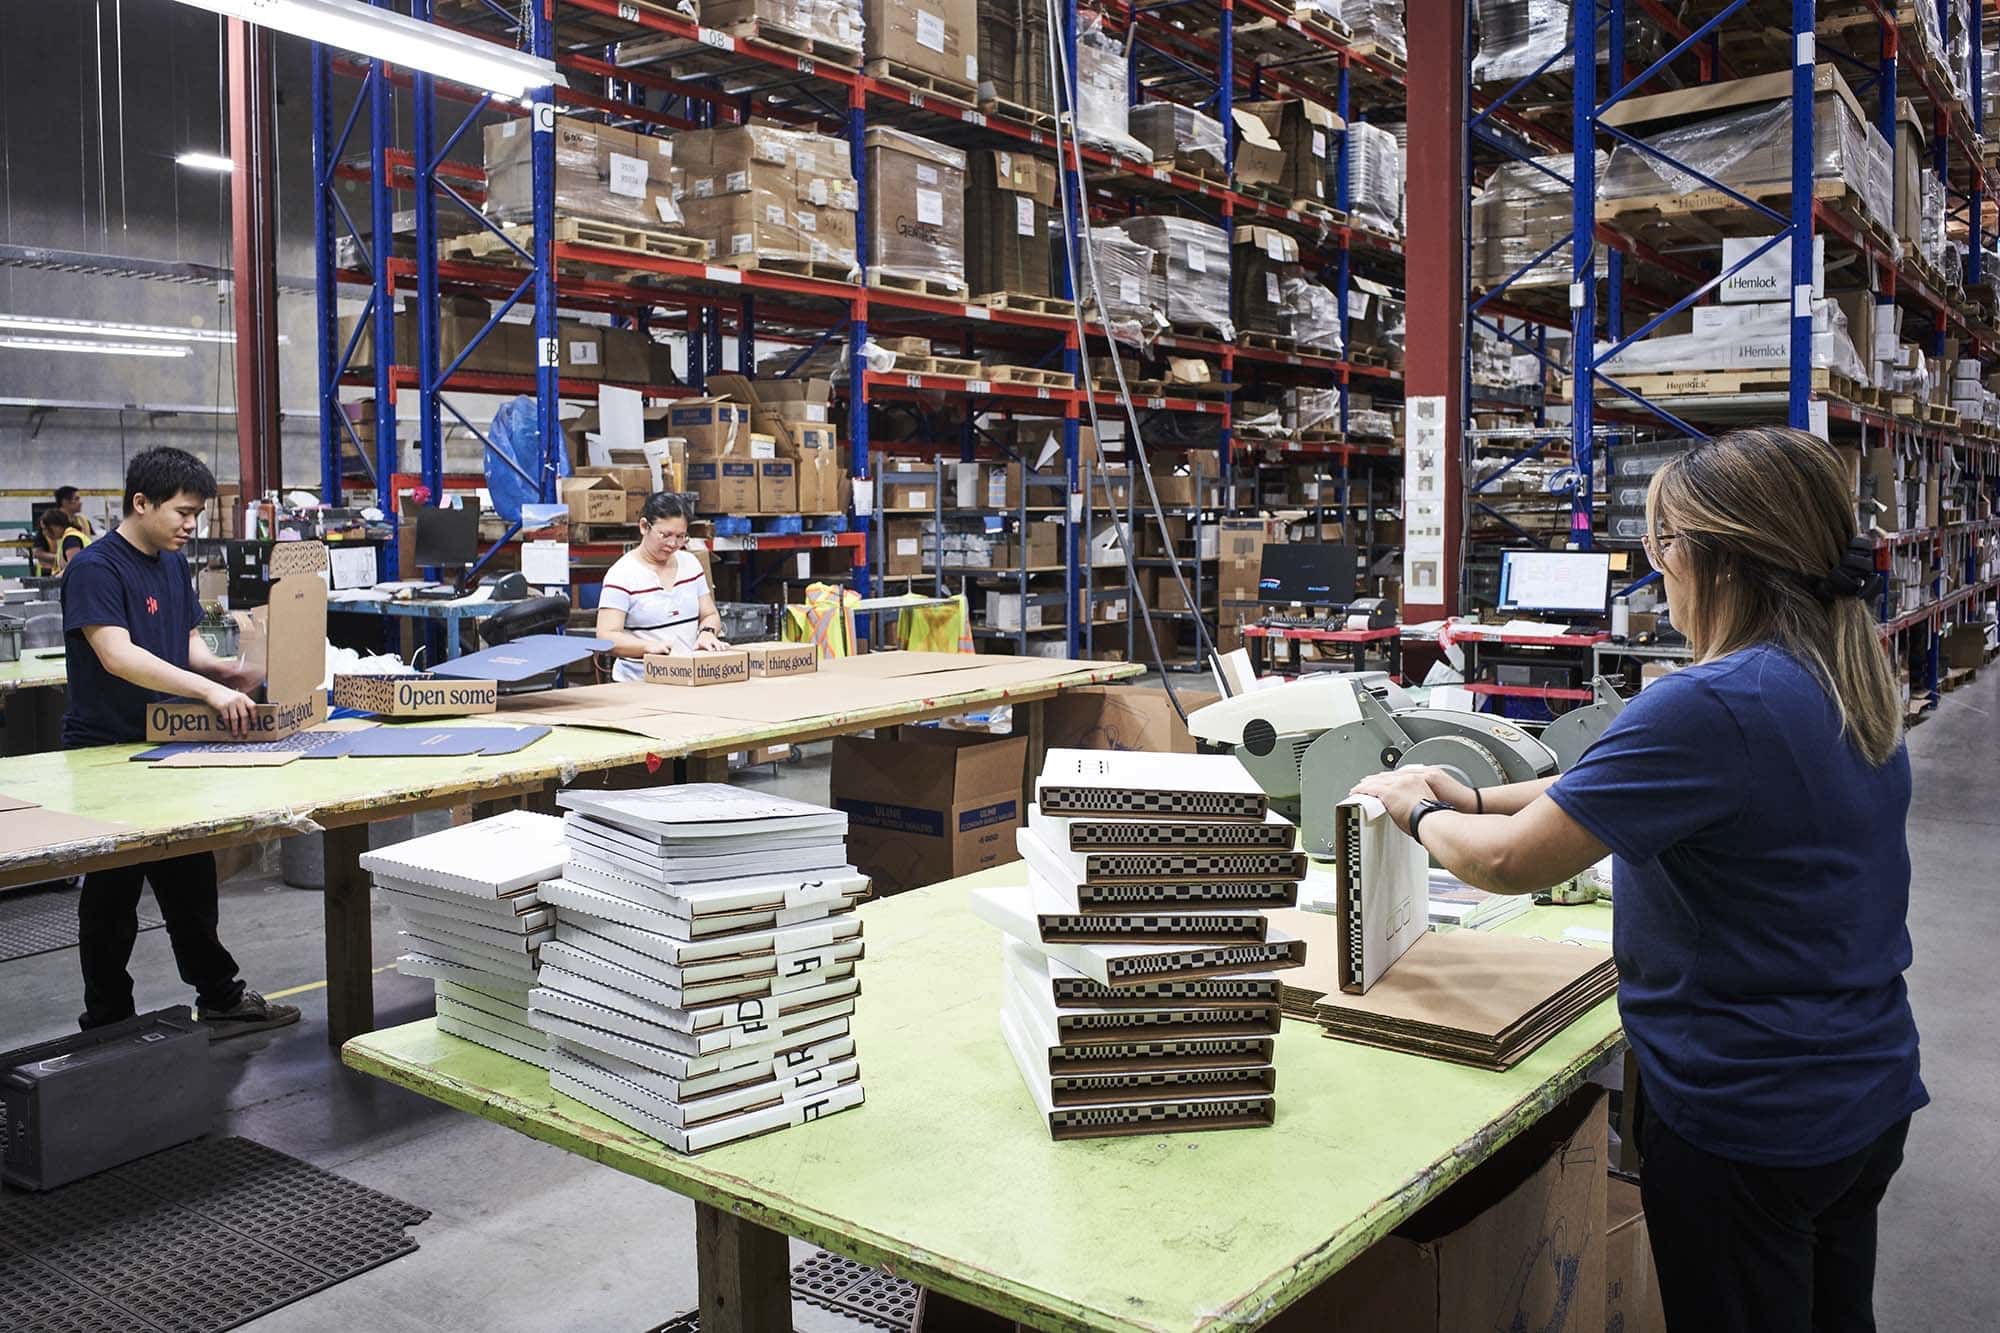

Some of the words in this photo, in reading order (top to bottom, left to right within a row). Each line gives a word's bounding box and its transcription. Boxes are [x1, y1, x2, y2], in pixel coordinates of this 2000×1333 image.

[709, 31, 725, 48] 08
[540, 107, 554, 128] C
[1733, 275, 1777, 289] Hemlock
[546, 342, 559, 362] B
[1744, 344, 1787, 358] Hemlock
[742, 537, 757, 551] 08
[646, 661, 669, 678] Open
[670, 666, 693, 678] some
[697, 663, 721, 680] thing
[750, 659, 765, 670] me
[769, 656, 791, 671] thing
[399, 684, 446, 710] Open
[449, 688, 496, 705] some
[152, 706, 211, 737] Open
[215, 712, 275, 732] se
[278, 703, 297, 730] thing
